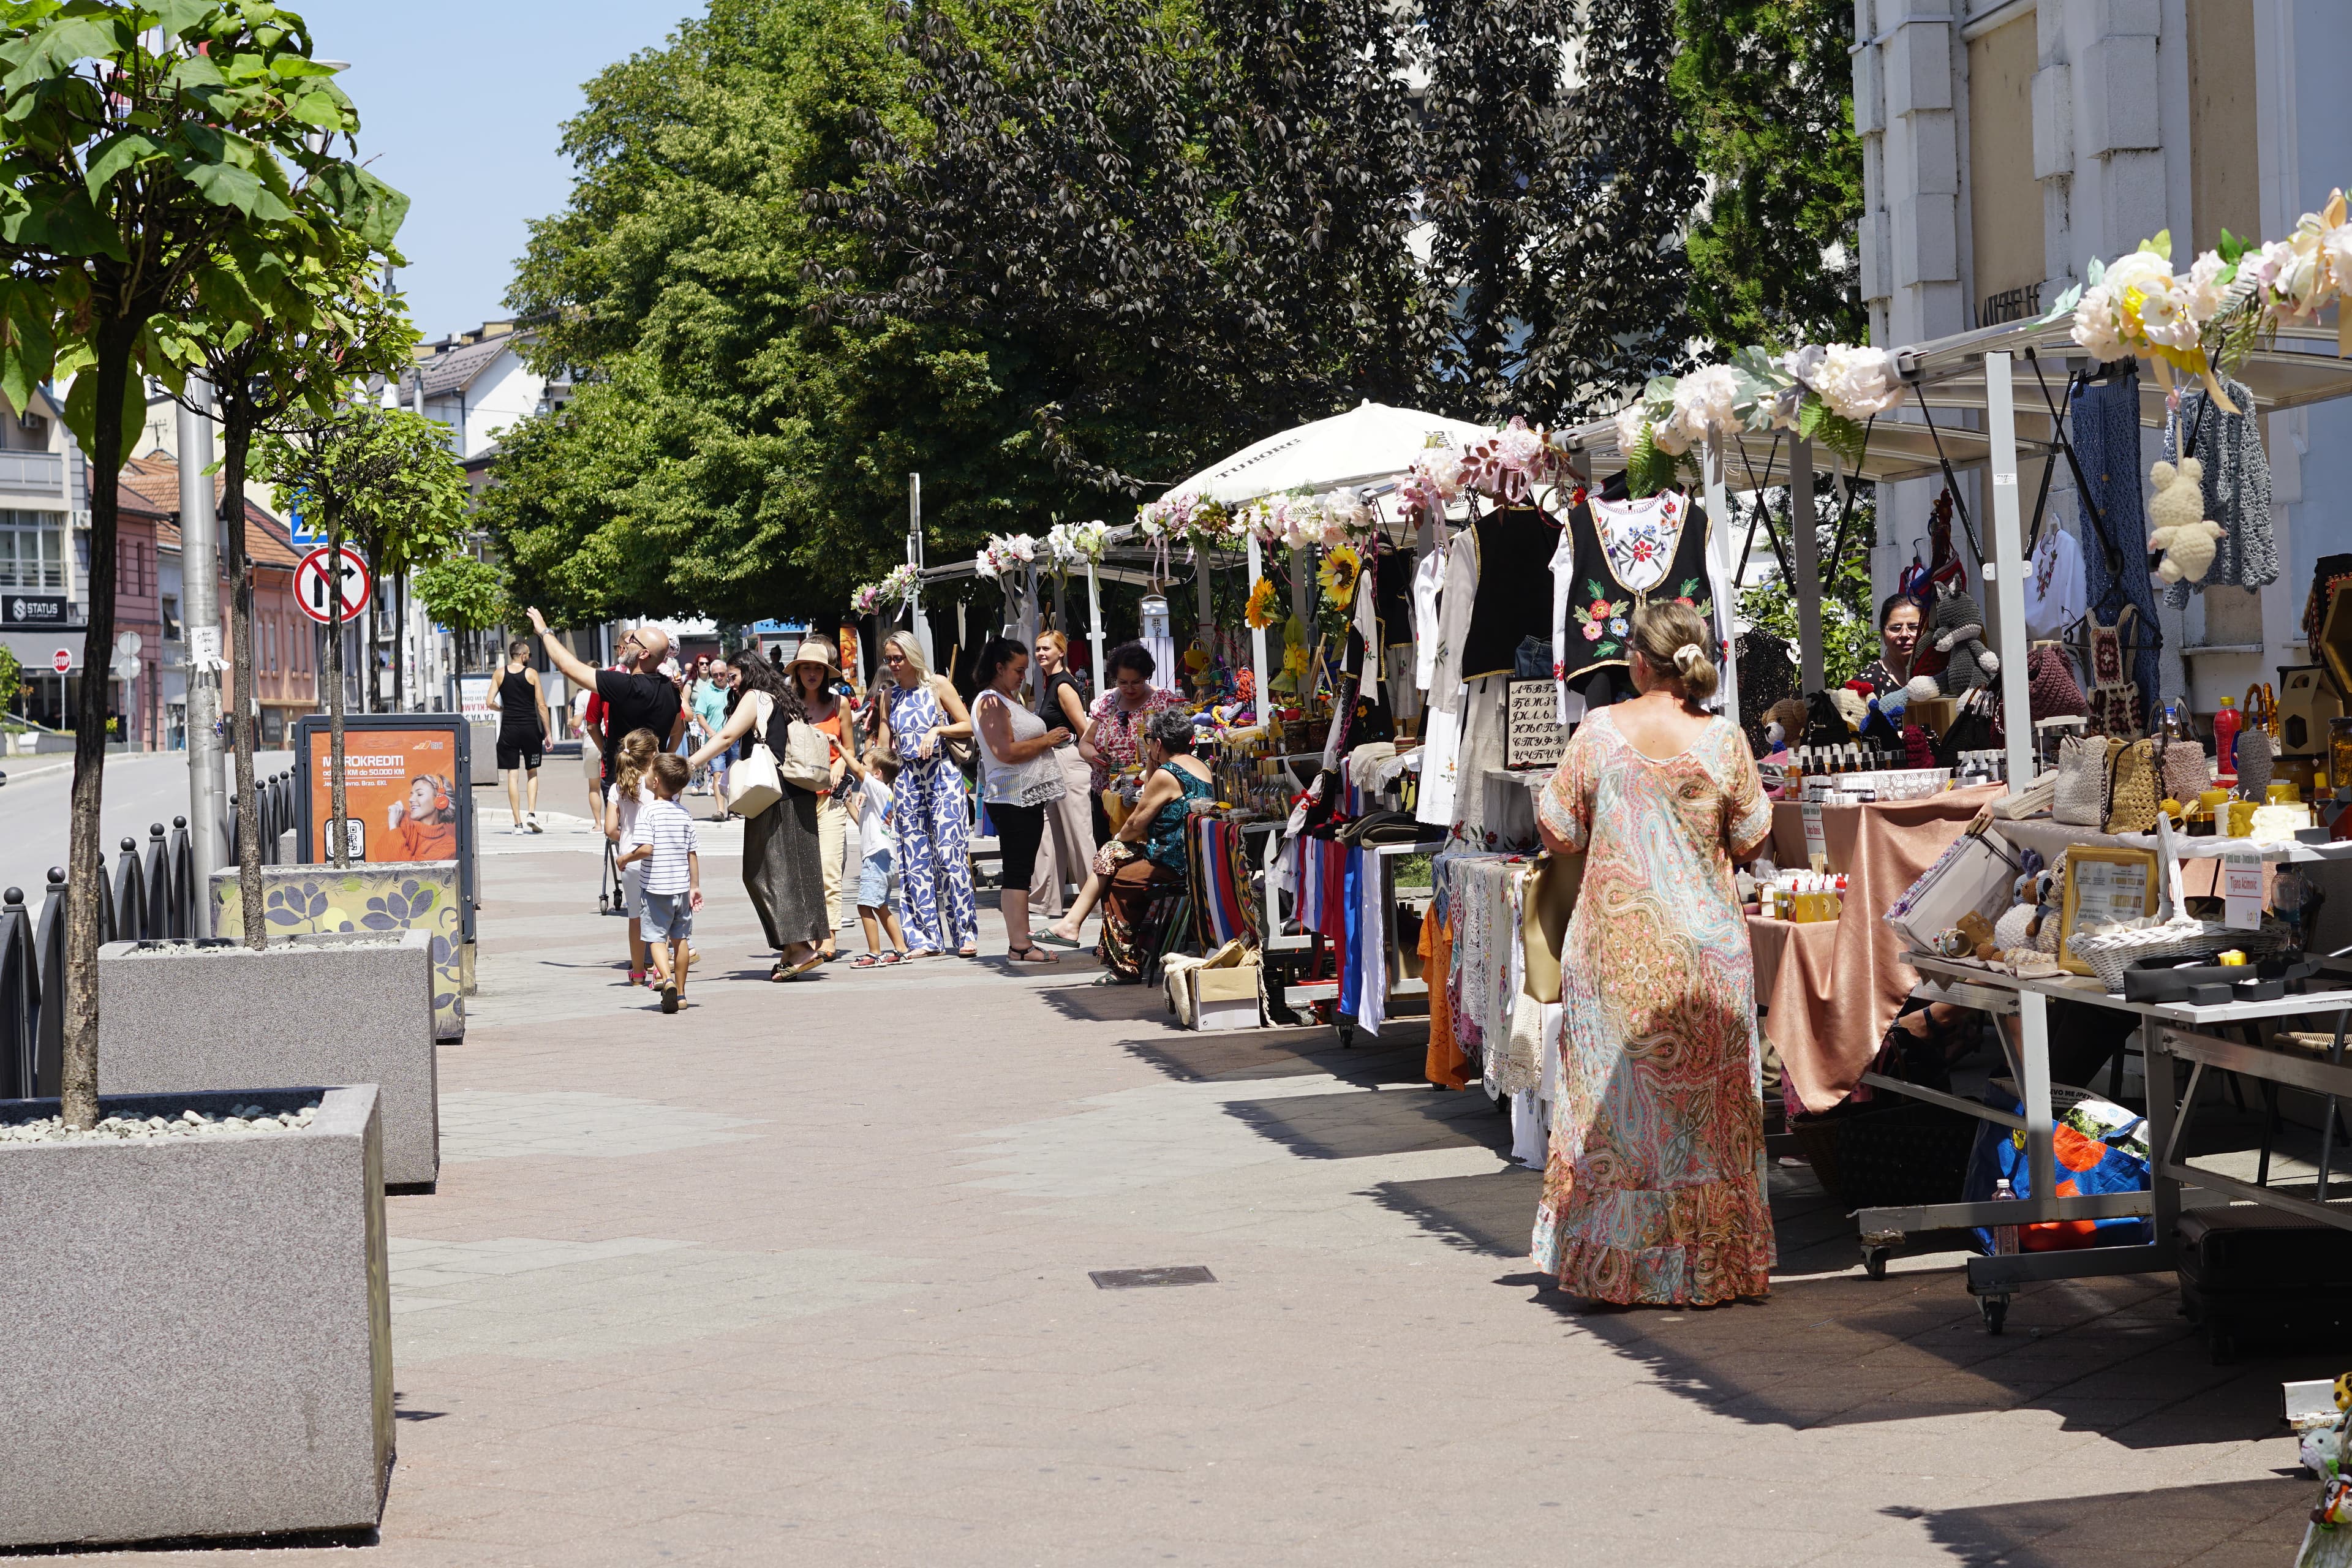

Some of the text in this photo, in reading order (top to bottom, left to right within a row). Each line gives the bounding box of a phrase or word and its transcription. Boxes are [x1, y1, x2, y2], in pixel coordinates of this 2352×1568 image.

[1215, 439, 1302, 478] TUBORG
[27, 603, 58, 614] STATUS
[55, 655, 70, 667] STOP
[323, 755, 404, 767] MROKREDITI
